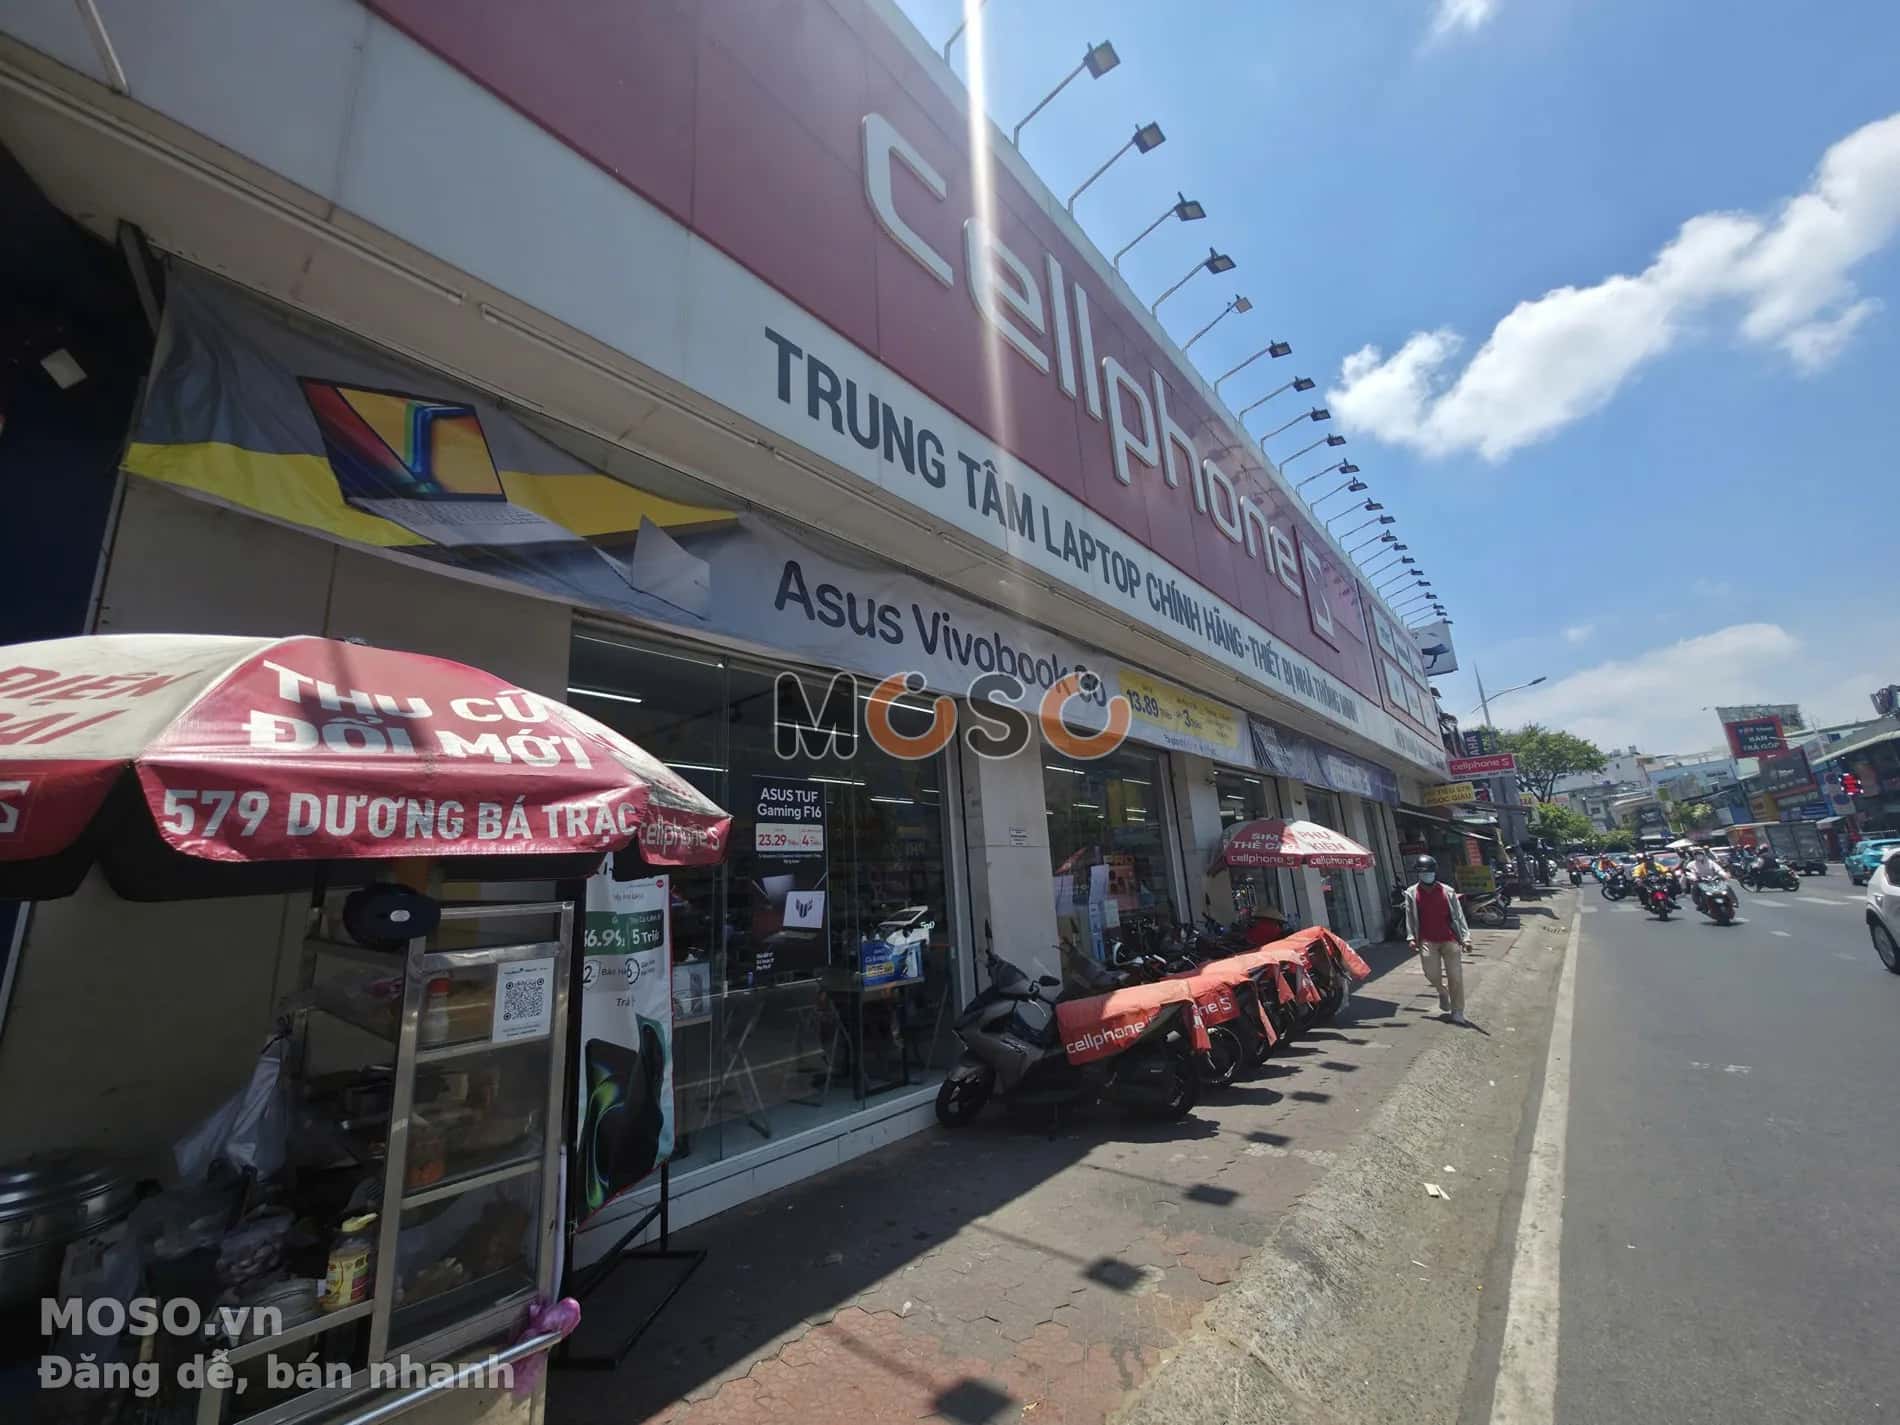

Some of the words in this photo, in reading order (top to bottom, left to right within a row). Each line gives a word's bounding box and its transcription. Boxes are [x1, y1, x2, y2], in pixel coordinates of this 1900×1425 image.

[764, 325, 947, 489] TRUNG
[958, 450, 1035, 543] TÂM
[1042, 505, 1142, 599] LAPTOP
[1146, 572, 1203, 636] CHÍNH
[774, 560, 905, 645] Asus
[912, 603, 1071, 697] Vivobook
[263, 660, 433, 720] THU
[449, 690, 552, 723] CŨ
[241, 710, 417, 756] ĐỔI
[435, 728, 593, 770] MỚI
[162, 788, 270, 838] 579
[286, 791, 464, 840] DƯƠNG
[477, 795, 533, 840] BÁ
[541, 801, 638, 846] TRẠC
[757, 803, 801, 820] Gaming
[803, 805, 823, 818] F16
[760, 787, 794, 802] ASUS
[795, 790, 819, 803] TUF
[759, 833, 788, 847] 23.29
